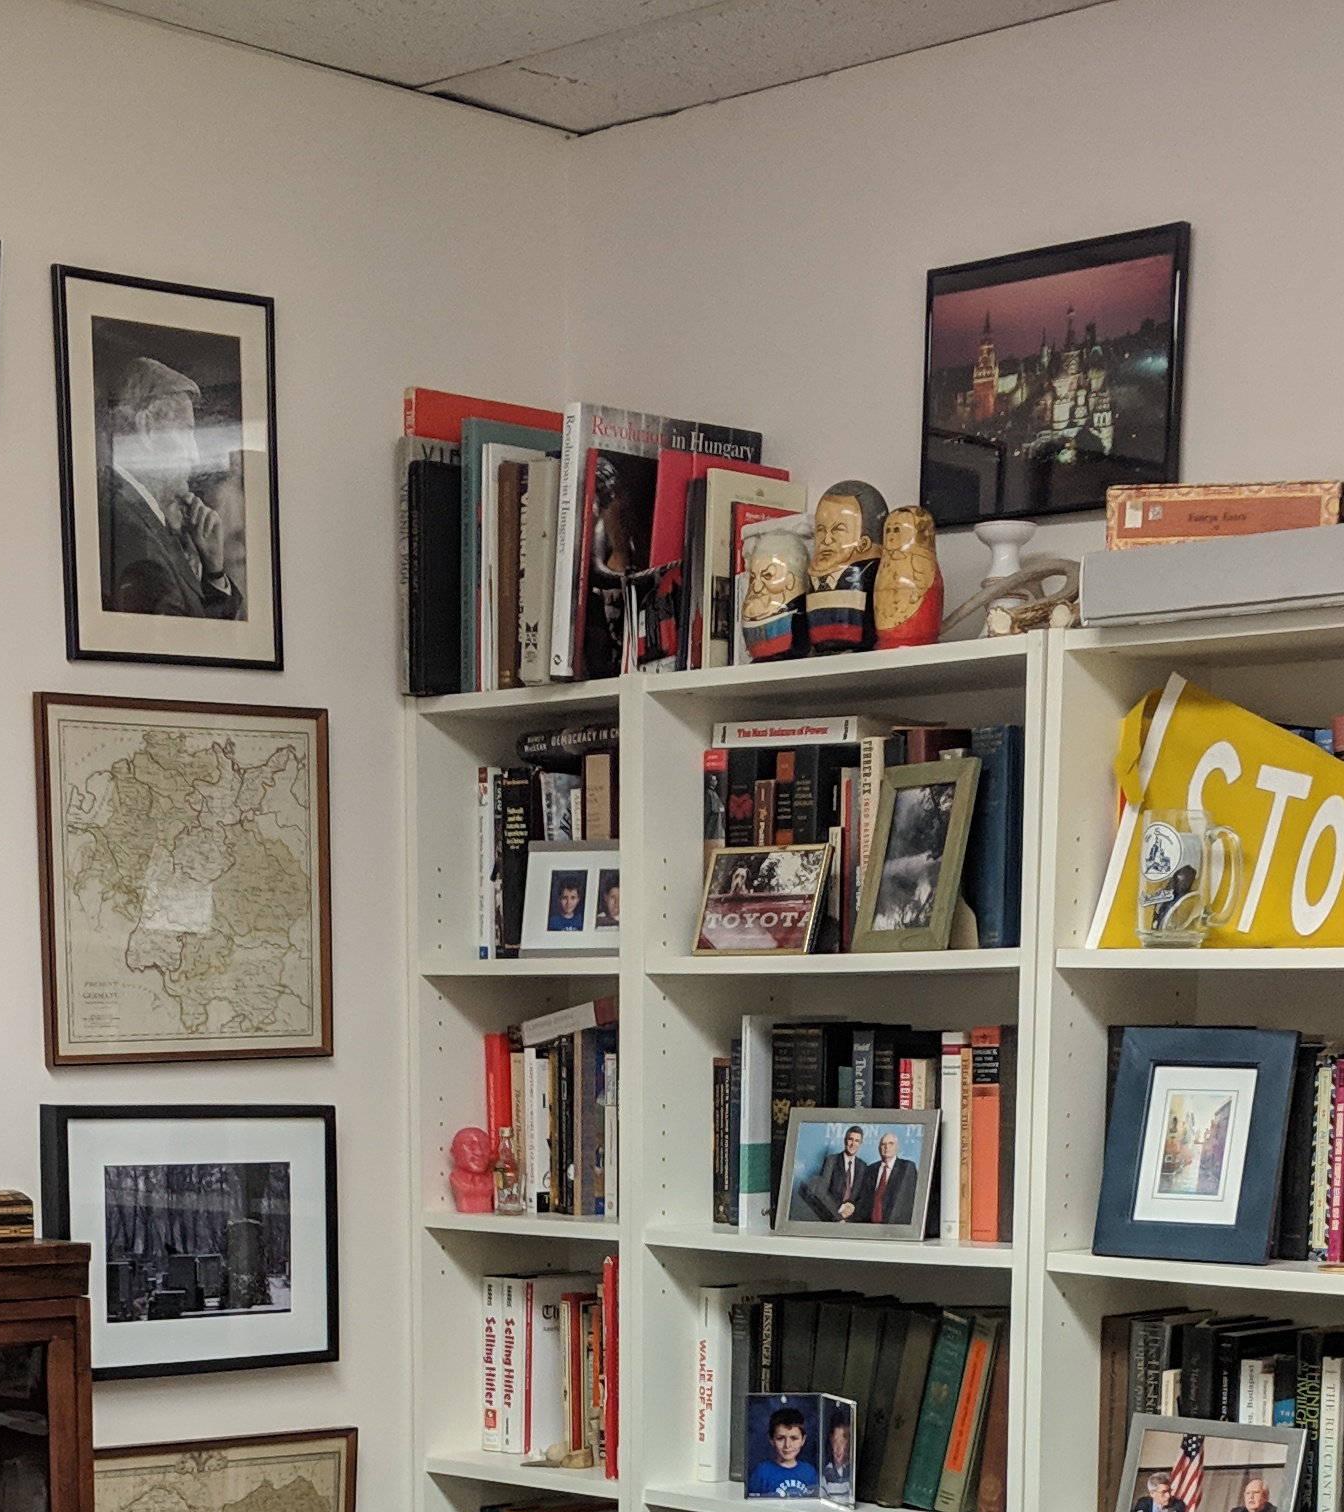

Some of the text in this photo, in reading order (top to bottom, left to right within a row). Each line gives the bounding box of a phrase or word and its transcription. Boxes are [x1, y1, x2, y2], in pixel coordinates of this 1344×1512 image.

[671, 428, 686, 450] in
[690, 431, 756, 461] Hungary
[557, 414, 576, 553] Revolution Hungary
[805, 725, 829, 736] Power
[704, 910, 811, 931] TOYOTA
[698, 1339, 707, 1383] WAKE
[761, 1302, 774, 1367] MESSENGER
[484, 1316, 497, 1408] Selling Hitler
[502, 1317, 516, 1409] Selling Hitler
[705, 1384, 713, 1412] THE
[1322, 1415, 1337, 1501] RELUCTANT
